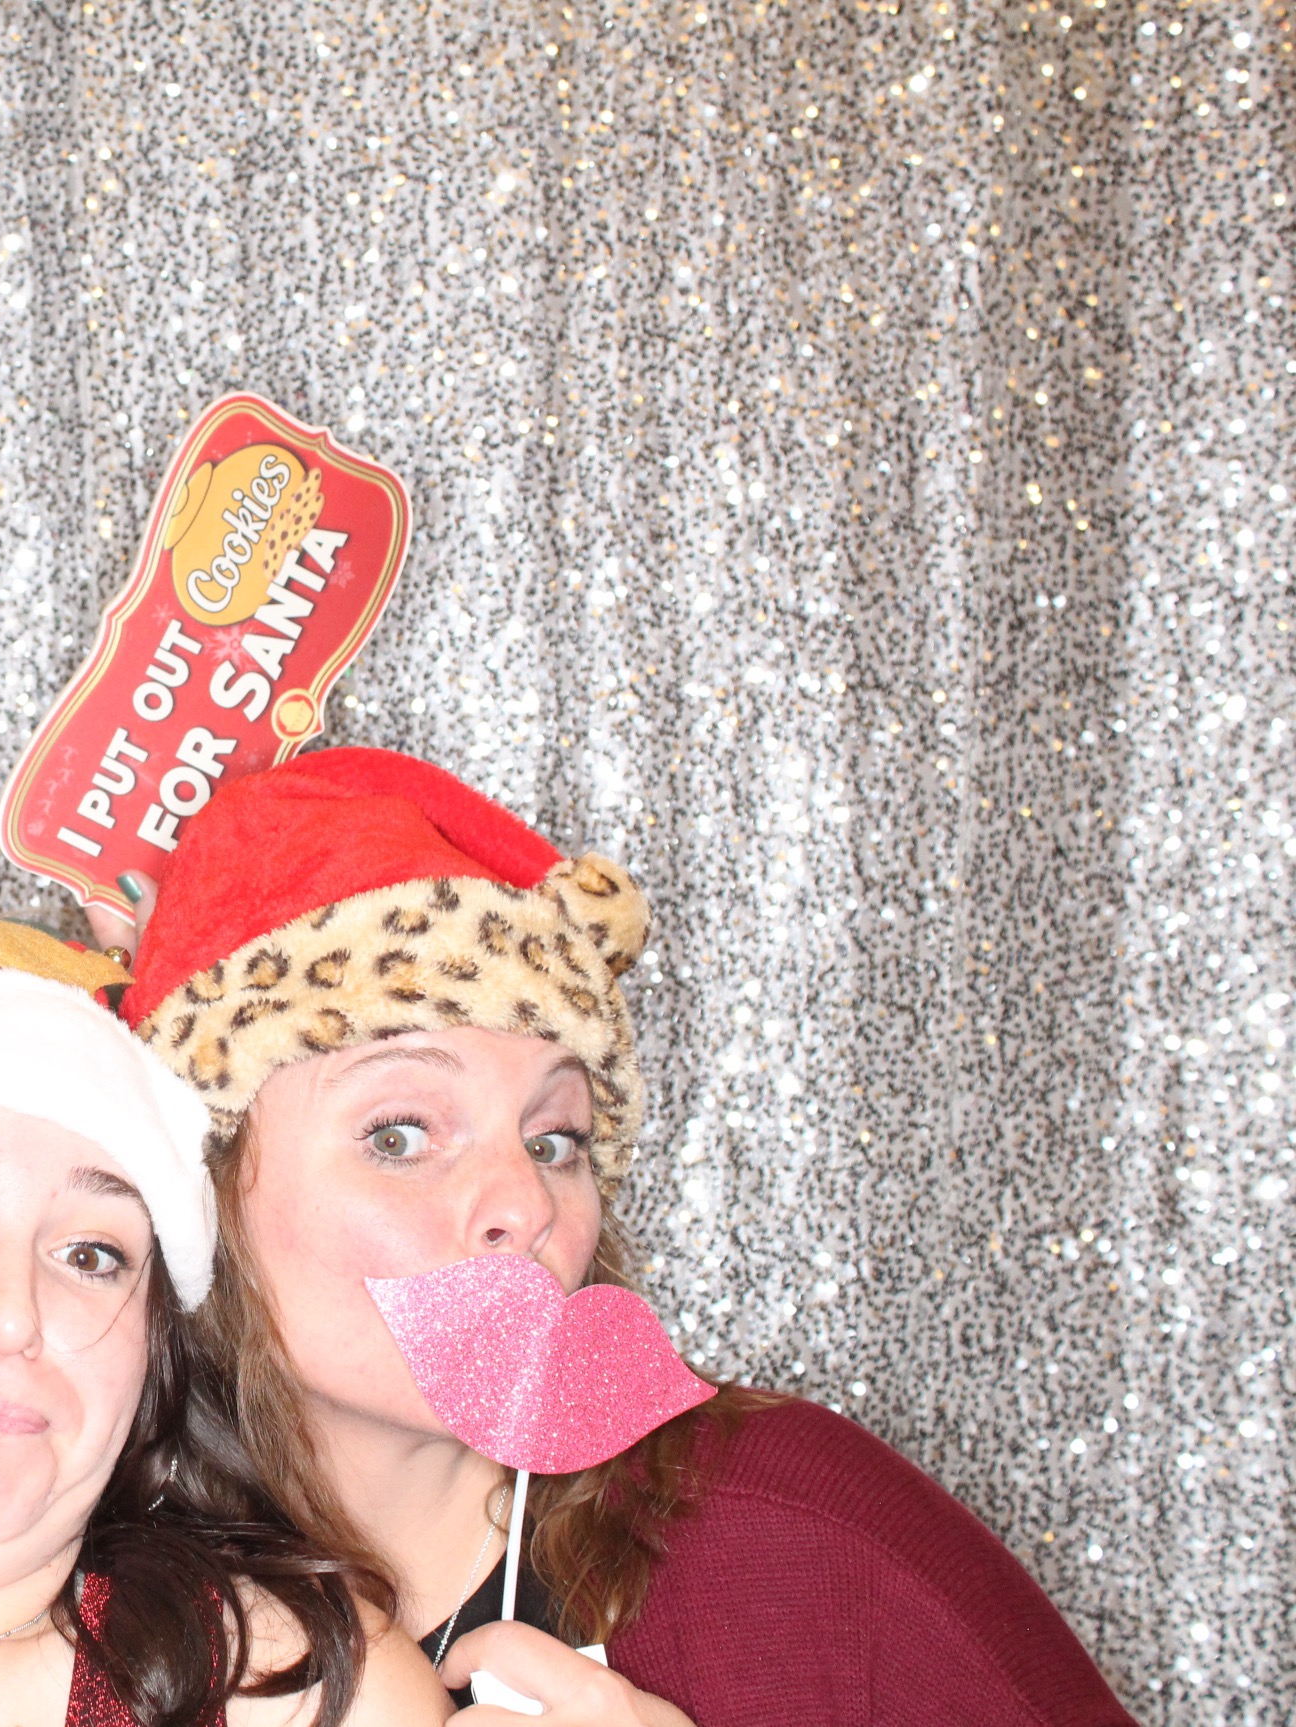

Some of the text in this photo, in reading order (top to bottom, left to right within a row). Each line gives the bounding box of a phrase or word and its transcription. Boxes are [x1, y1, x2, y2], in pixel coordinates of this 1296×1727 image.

[56, 454, 292, 857] I PUT OUT Cookies
[136, 527, 349, 853] FOR SANTA
